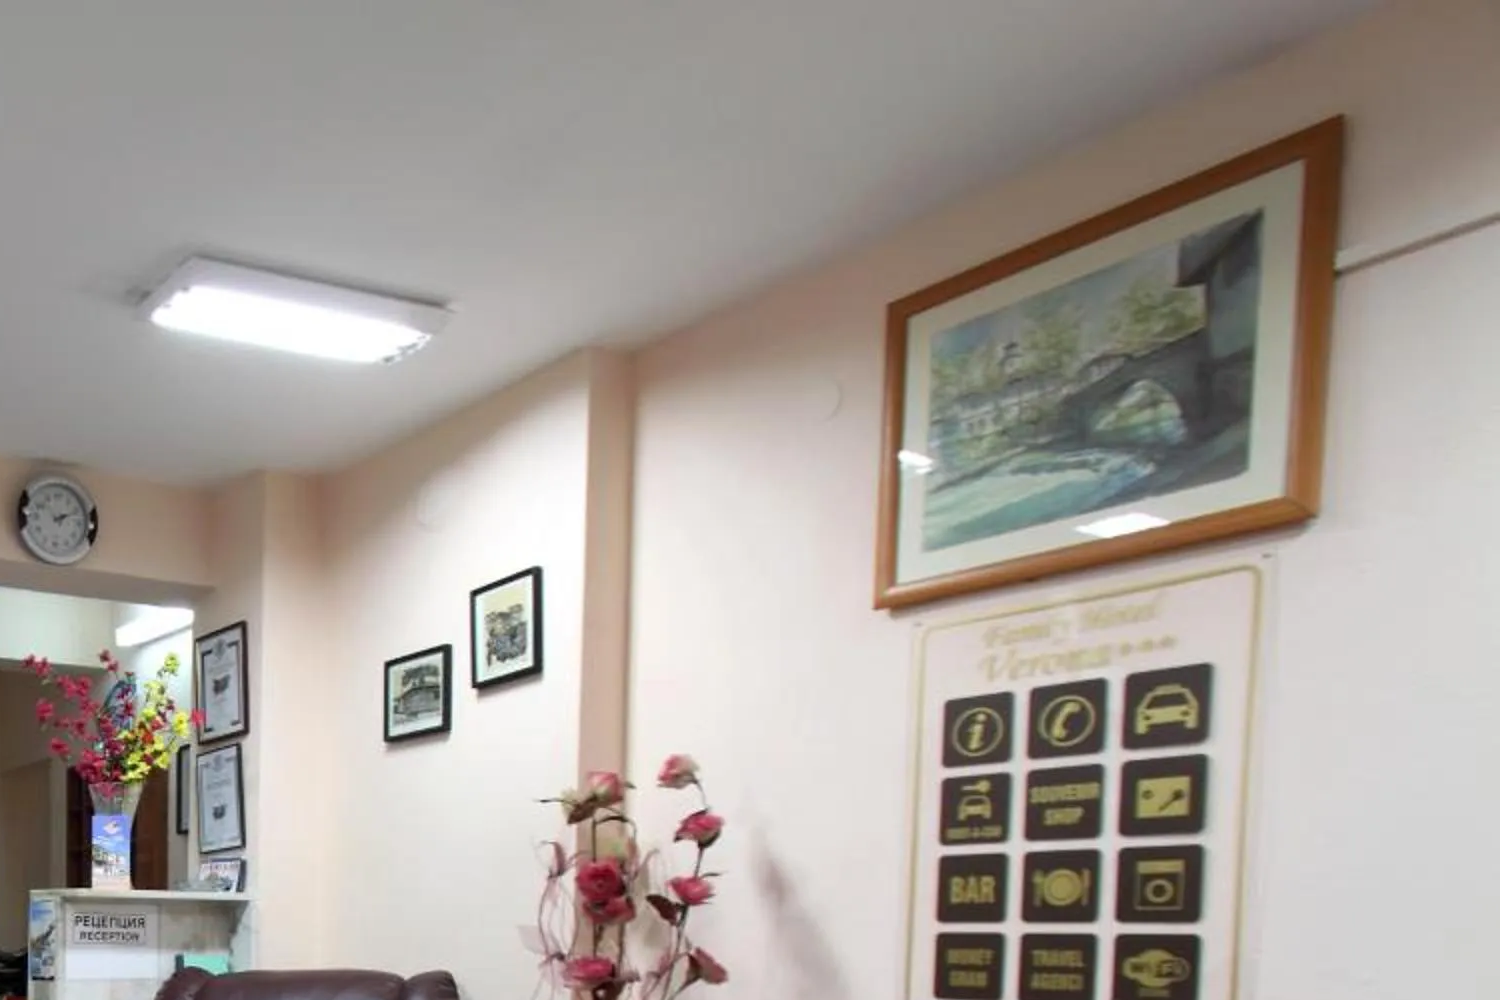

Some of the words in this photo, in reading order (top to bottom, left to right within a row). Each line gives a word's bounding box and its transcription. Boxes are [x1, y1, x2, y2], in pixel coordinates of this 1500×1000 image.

[950, 875, 995, 904] BAR
[74, 914, 146, 929] РЕЦЕПЦИЯ
[79, 930, 140, 942] RECEPTION
